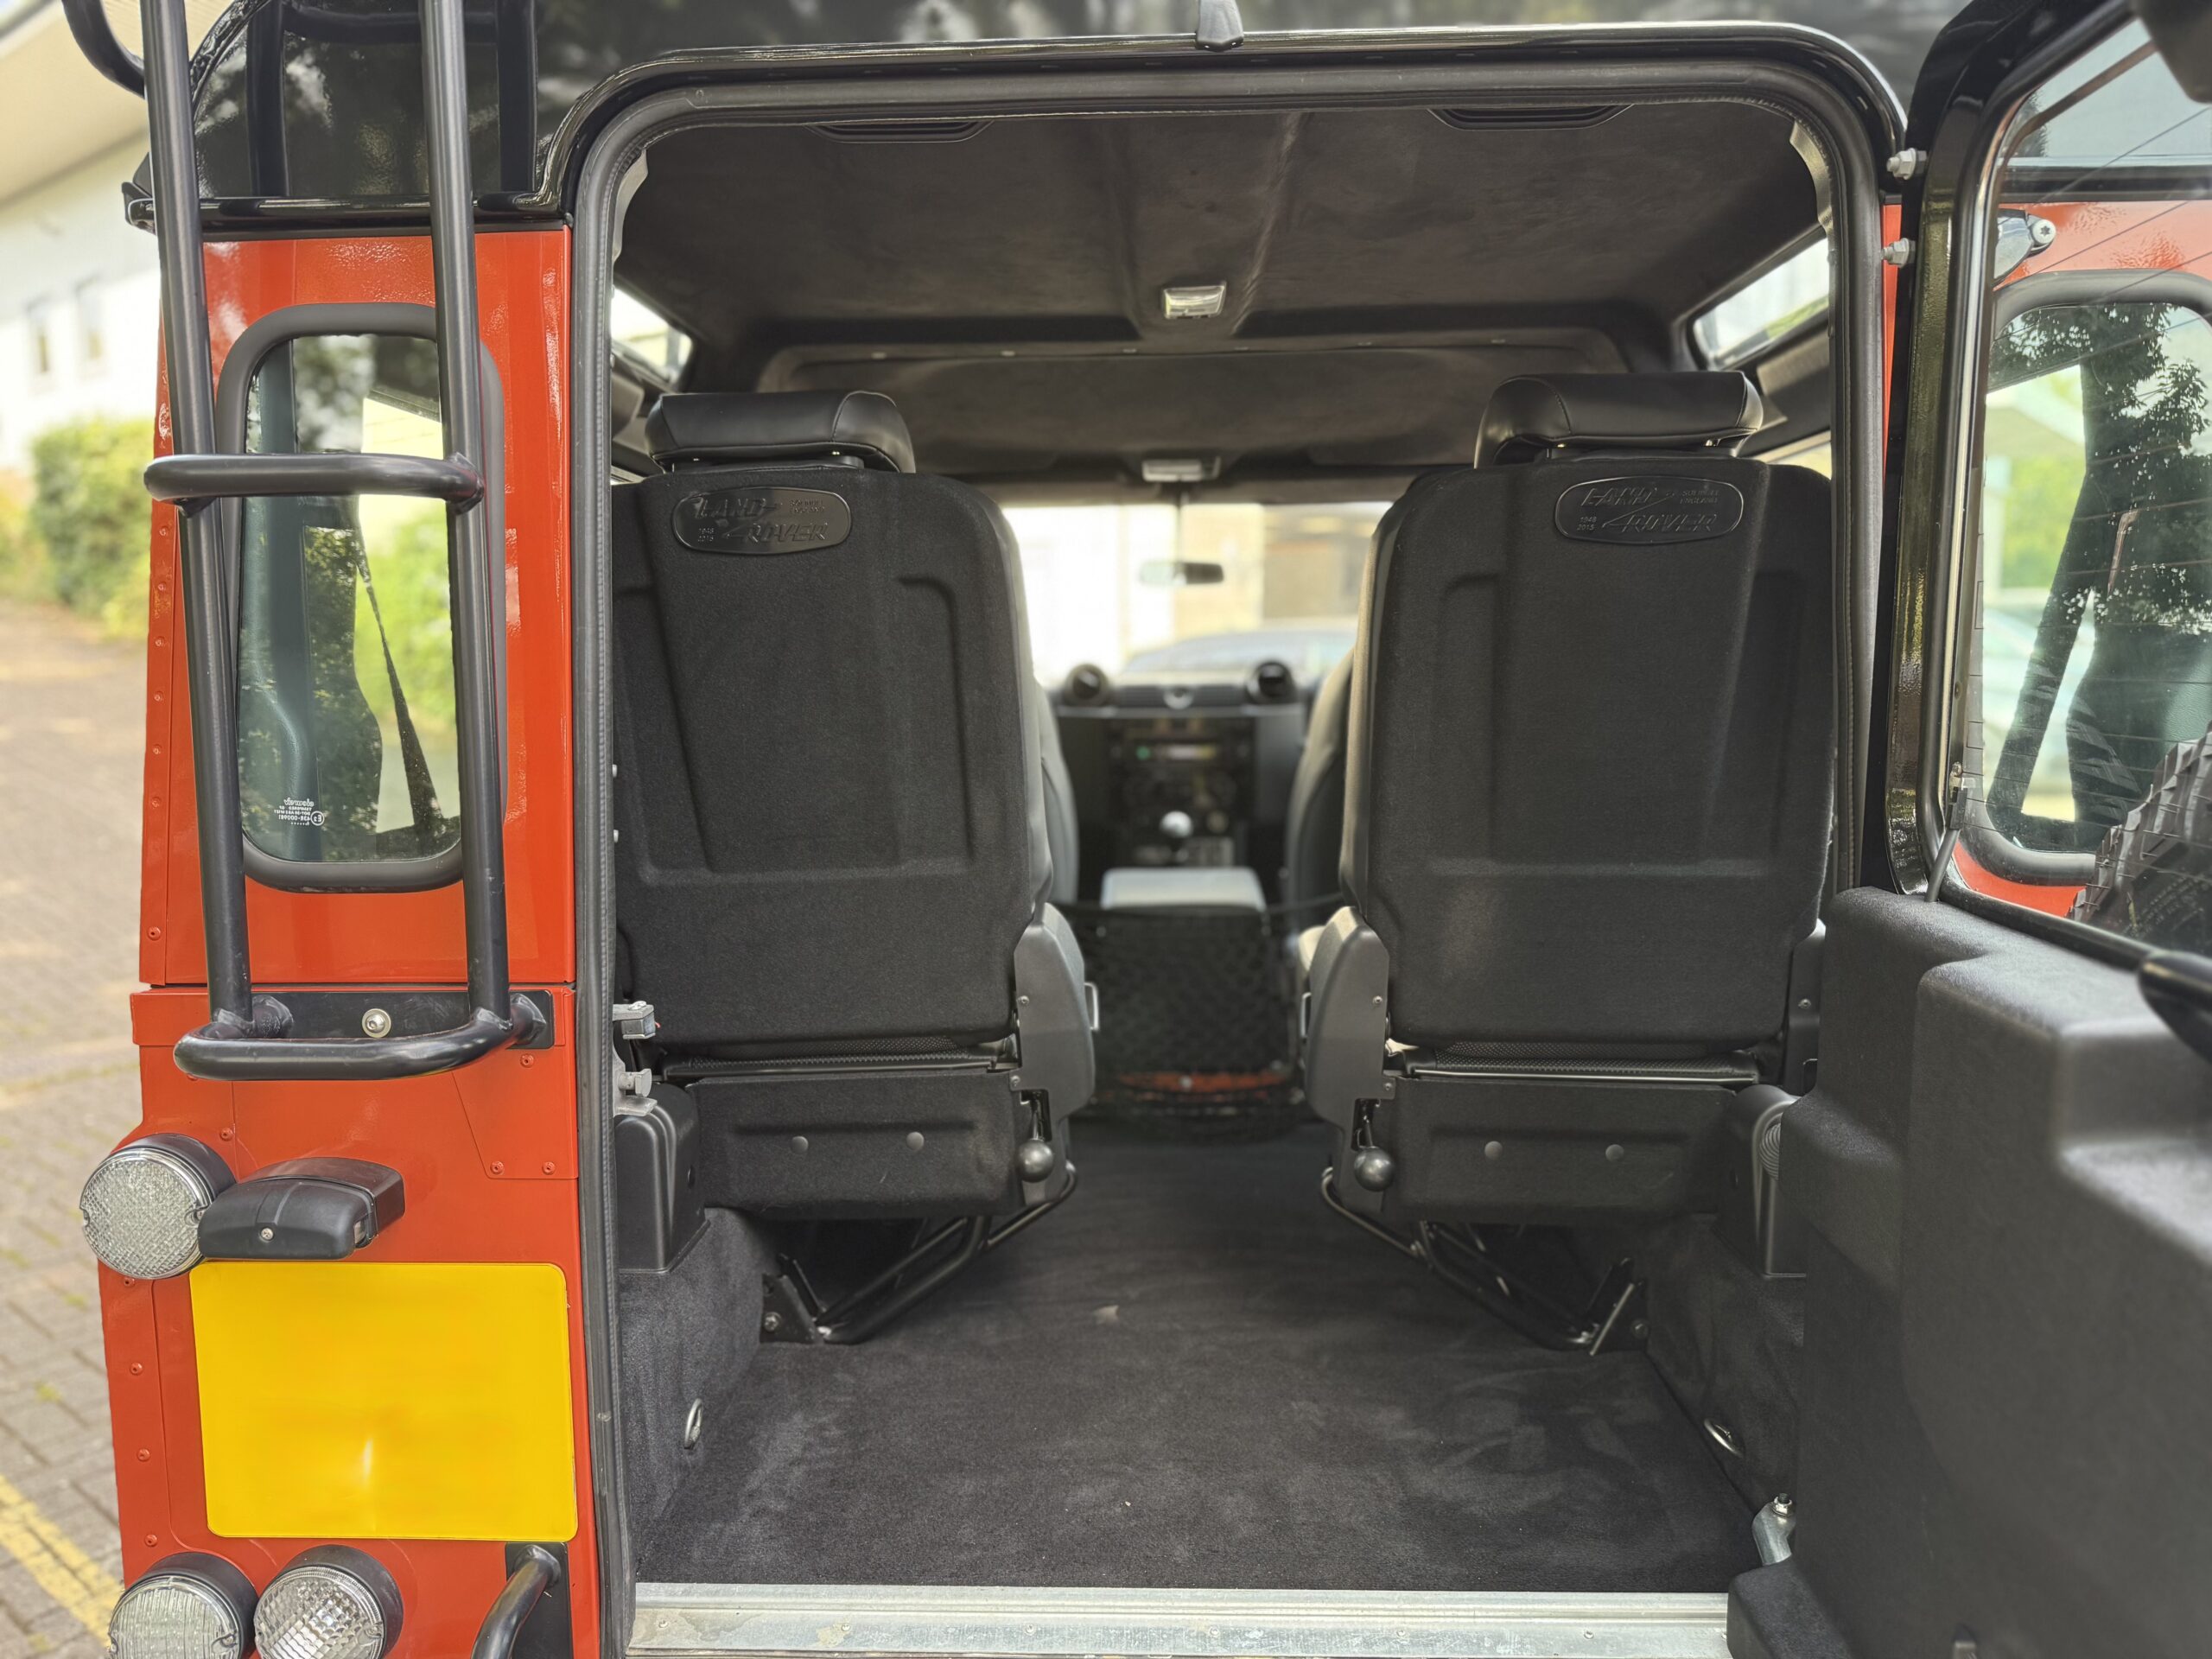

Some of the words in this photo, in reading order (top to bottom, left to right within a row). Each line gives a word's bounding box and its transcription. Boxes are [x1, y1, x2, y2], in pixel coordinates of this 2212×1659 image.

[1580, 486, 1658, 506] LAND
[694, 497, 767, 519] LAND
[742, 522, 830, 543] ROVER
[1622, 513, 1718, 533] ROVER
